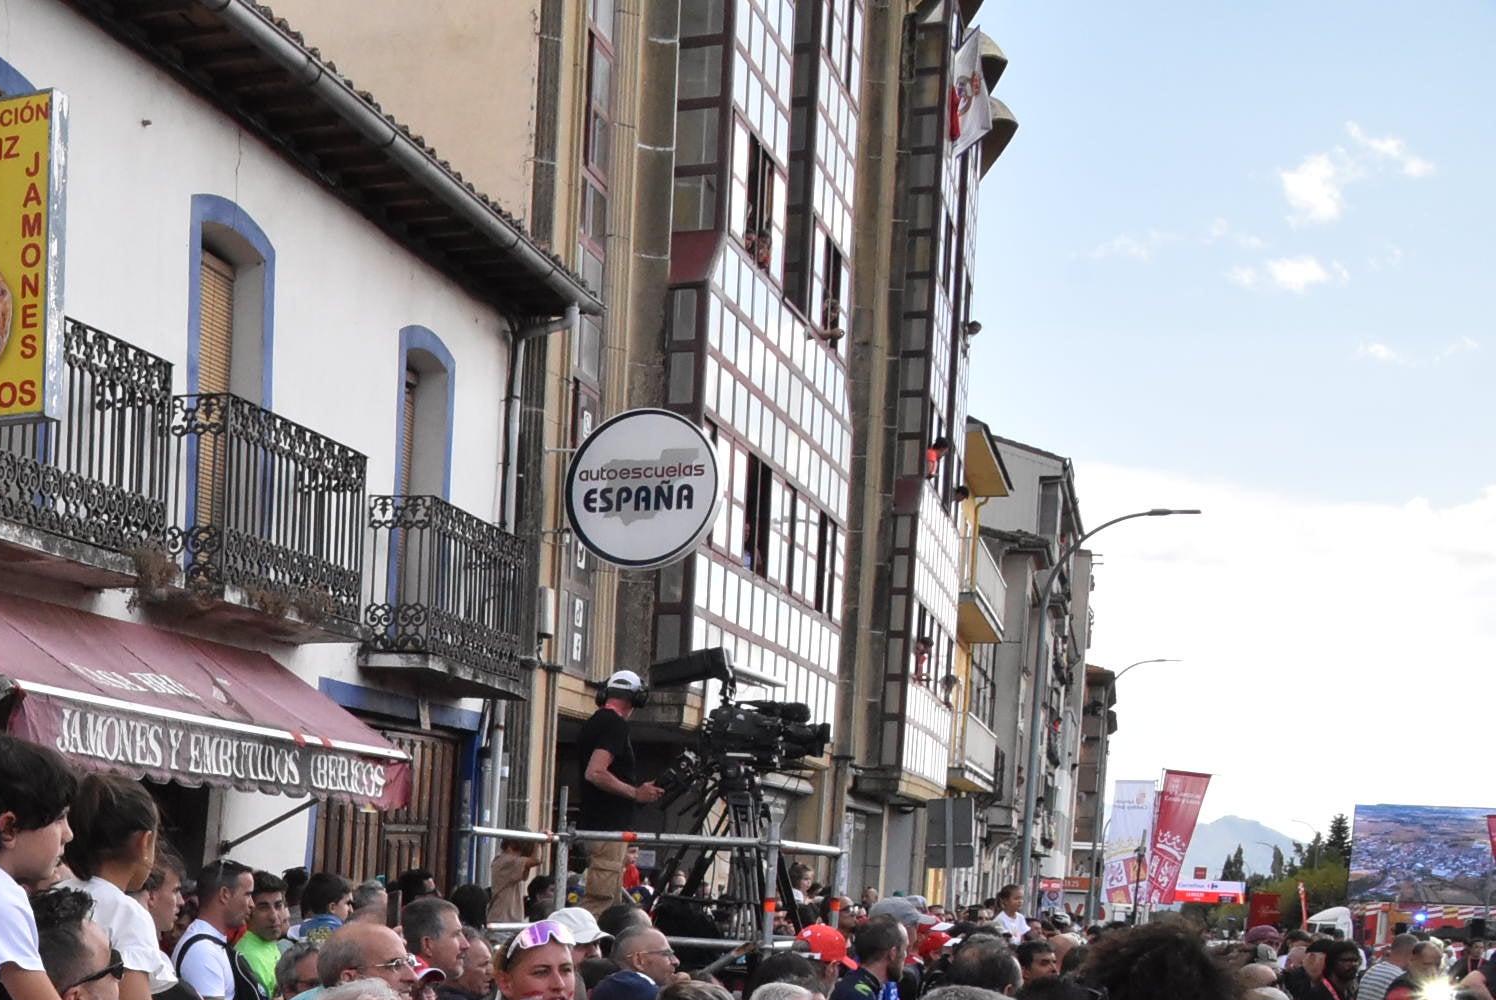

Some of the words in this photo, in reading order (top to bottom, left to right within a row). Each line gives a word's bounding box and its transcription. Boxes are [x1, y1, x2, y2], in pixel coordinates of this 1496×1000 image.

[19, 151, 42, 360] JAMONES
[578, 462, 706, 482] autoescuelas
[583, 480, 694, 514] ESPAÑA
[56, 708, 164, 768] JAMONES
[169, 728, 184, 770] Y
[189, 733, 301, 785] EMBUTIDOS
